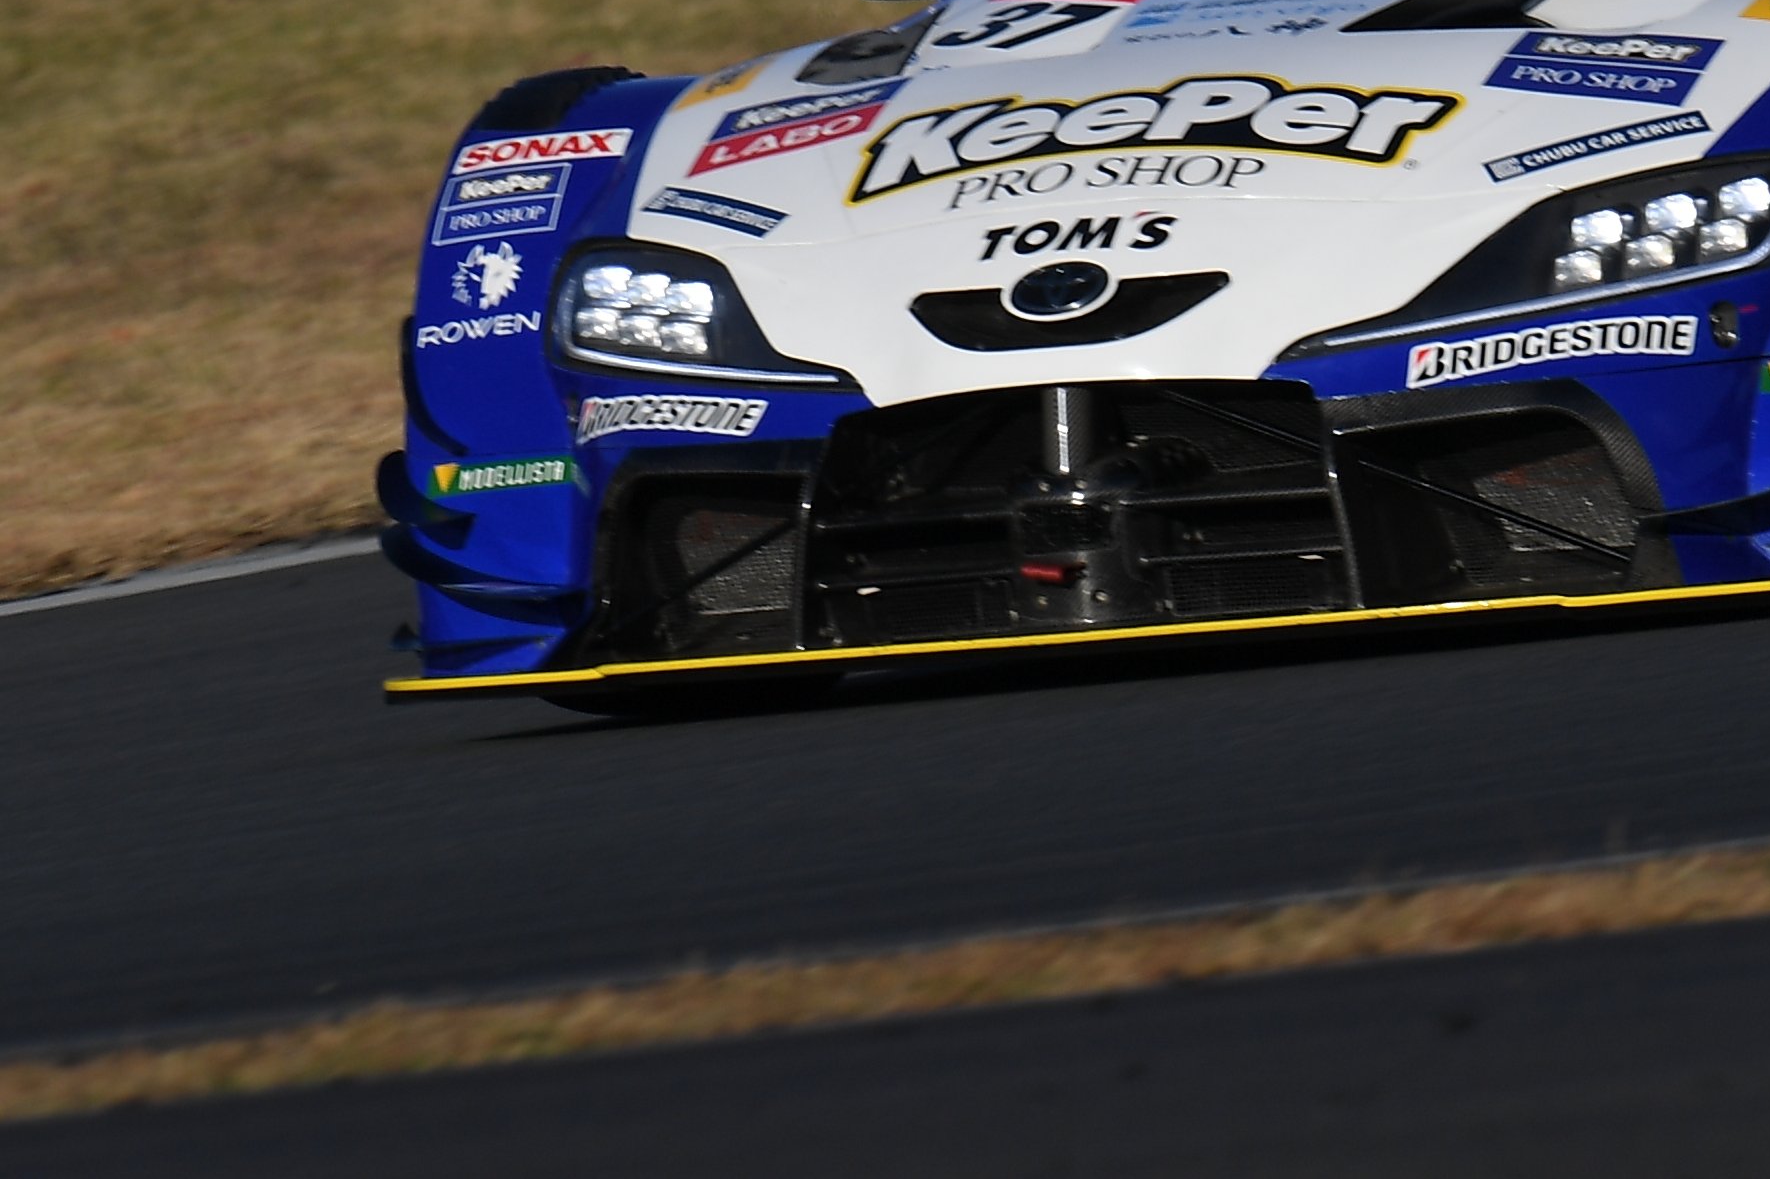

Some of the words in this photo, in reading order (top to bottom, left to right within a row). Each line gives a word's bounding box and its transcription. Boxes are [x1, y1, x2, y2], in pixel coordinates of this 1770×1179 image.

[931, 1, 1119, 49] 37
[1536, 36, 1699, 62] KeePer
[1509, 63, 1577, 86] PRO
[1582, 69, 1678, 95] SHOP
[458, 132, 615, 169] SONAX
[707, 113, 861, 165] LABO
[861, 78, 1447, 196] KeePer
[1521, 141, 1588, 168] CHUBU
[1587, 131, 1629, 151] CAR
[1629, 114, 1705, 141] SERVICE
[457, 172, 552, 202] KeePer
[949, 159, 1073, 211] PRO
[1085, 154, 1266, 189] SHOP
[448, 209, 488, 231] PRO
[488, 203, 547, 229] SHOP
[979, 211, 1178, 261] TOM'S
[416, 310, 541, 349] ROWEN
[1409, 318, 1695, 387] BRIDGESTONE
[577, 396, 767, 443] BRIDGESTONE
[458, 459, 566, 491] MODELLISTA
